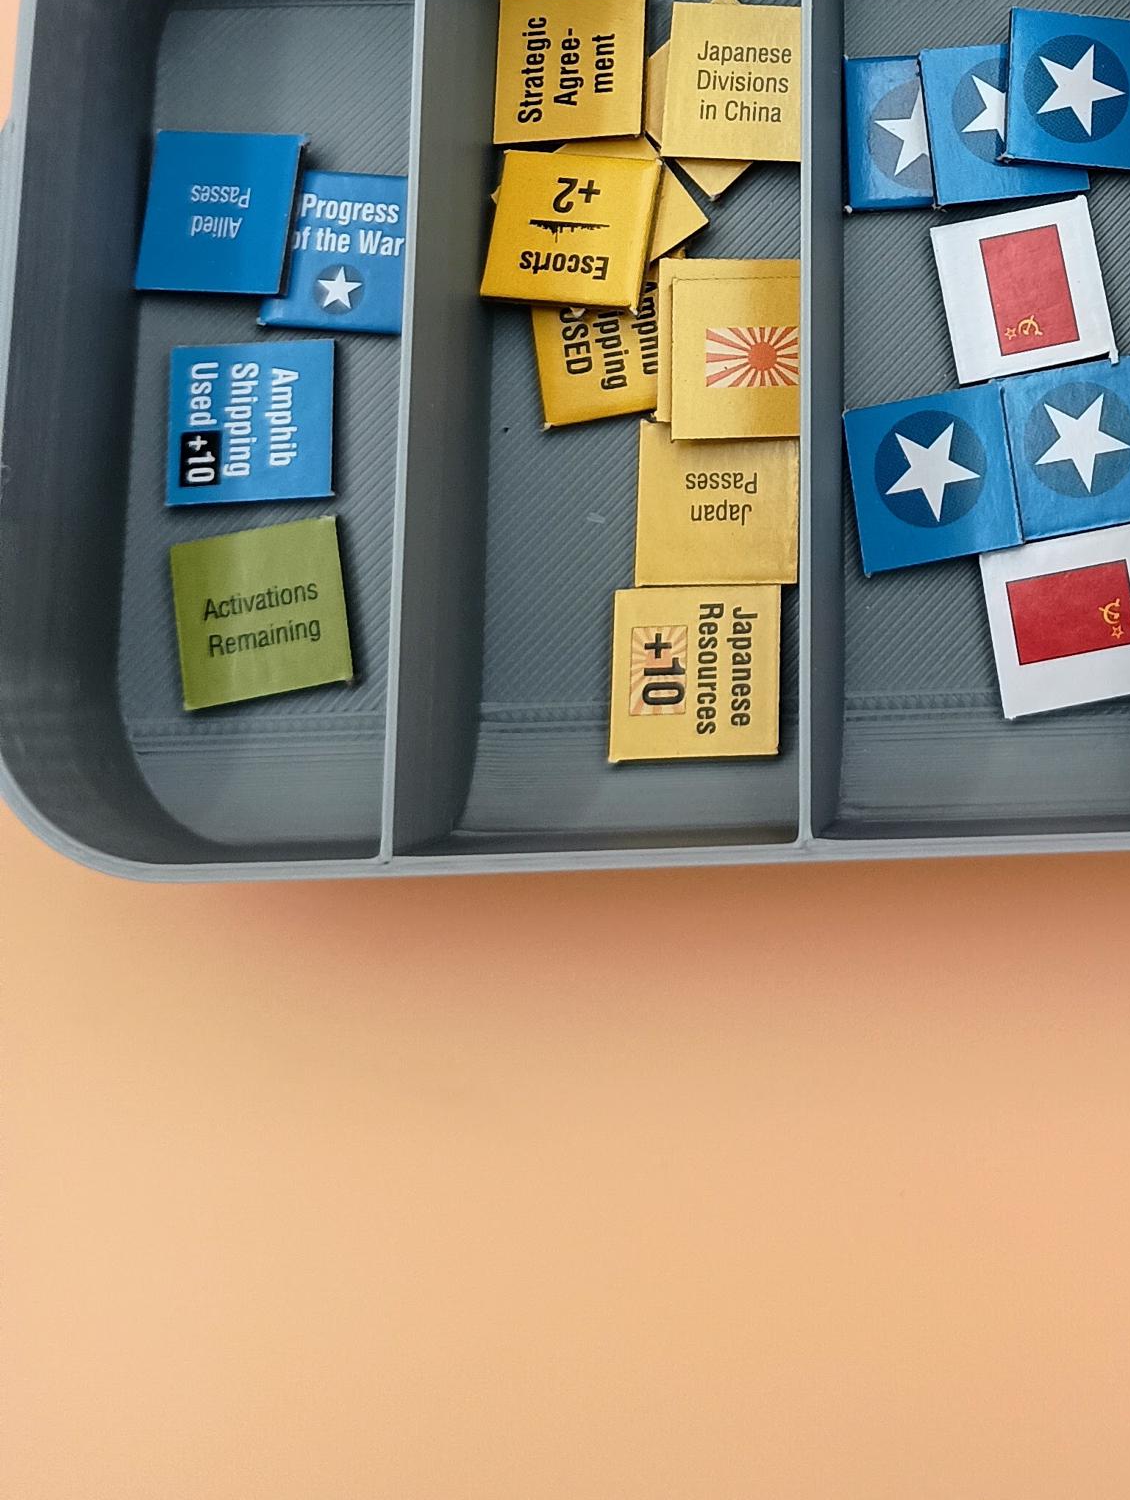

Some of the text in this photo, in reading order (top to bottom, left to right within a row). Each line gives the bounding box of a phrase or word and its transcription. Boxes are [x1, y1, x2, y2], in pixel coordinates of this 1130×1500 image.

[517, 16, 552, 124] Strategic
[553, 27, 584, 107] Agree-
[591, 33, 616, 95] ment
[696, 40, 793, 68] Japanese
[696, 70, 790, 95] Divisions
[699, 100, 782, 124] in China
[190, 184, 252, 209] Passes
[301, 193, 400, 226] Progress
[552, 177, 602, 214] +2
[191, 215, 243, 240] Allied
[315, 227, 351, 253] the
[359, 229, 405, 257] War
[519, 250, 610, 282] Escorts
[592, 308, 628, 390] ipping
[186, 361, 219, 484] Used +10
[222, 362, 260, 478] Shipping
[264, 366, 300, 468] Amphib
[685, 472, 758, 495] Passes
[690, 500, 752, 526] Japan
[203, 582, 318, 621] Activations
[208, 619, 321, 658] Remaining
[641, 632, 686, 706] +10
[696, 603, 725, 735] Resources
[726, 605, 758, 727] Japanese
